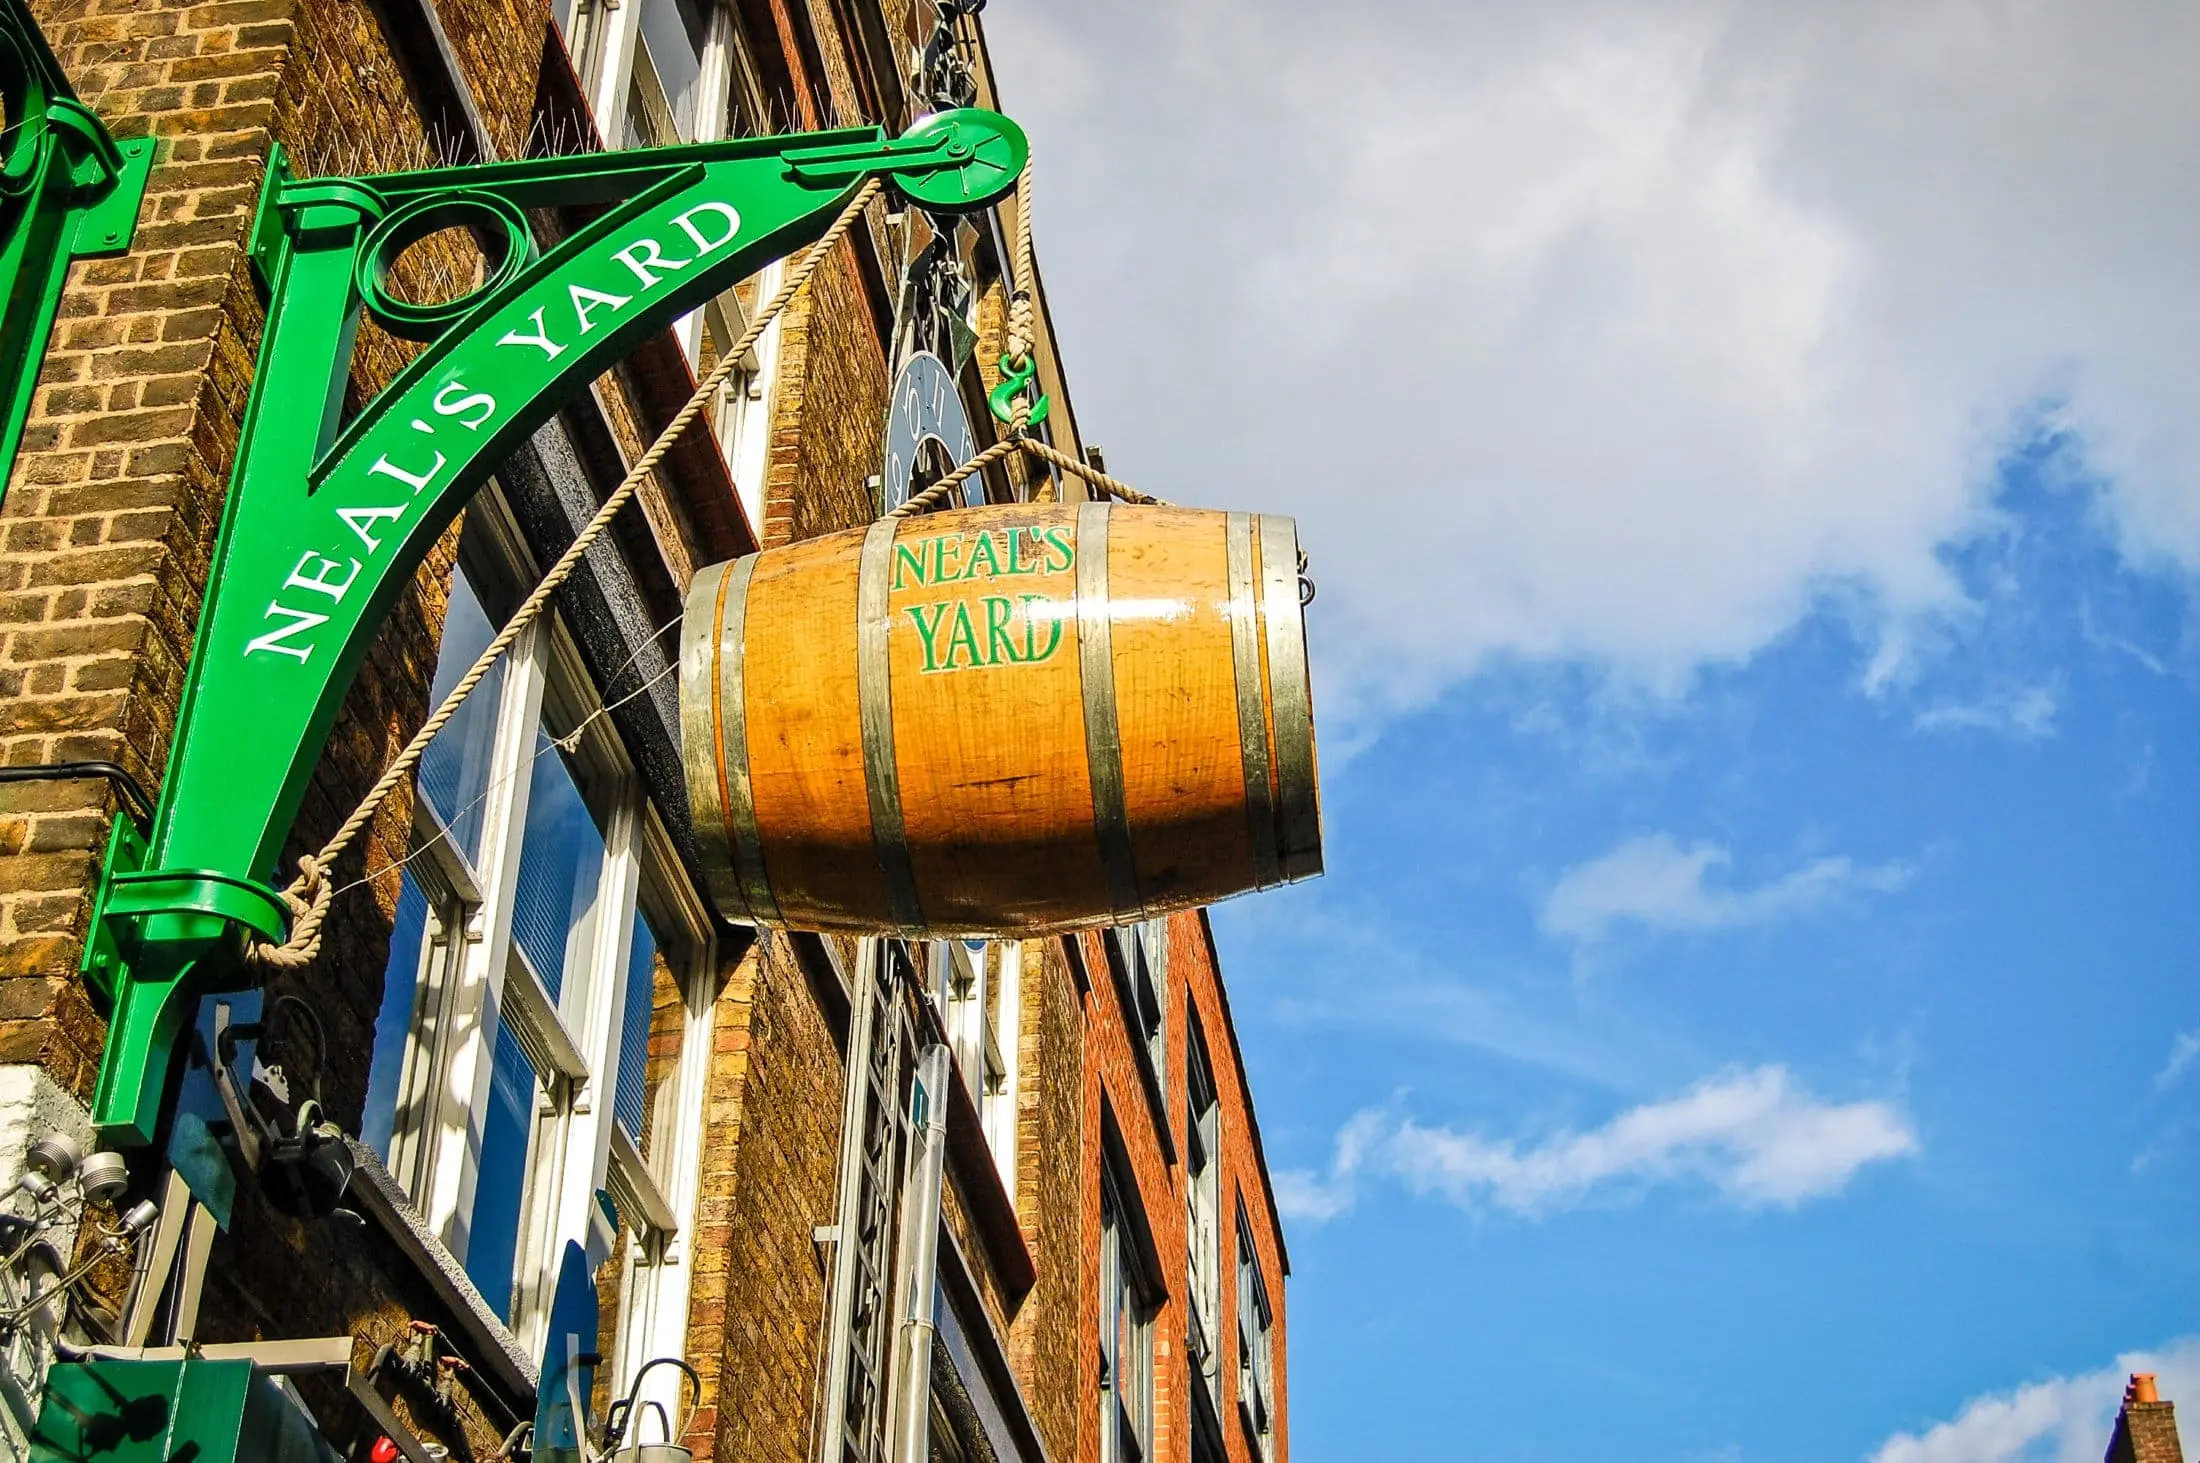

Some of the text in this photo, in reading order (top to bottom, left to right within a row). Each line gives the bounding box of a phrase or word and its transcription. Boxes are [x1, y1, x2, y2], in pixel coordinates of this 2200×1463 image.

[244, 202, 742, 665] NEAL'S YARD
[892, 527, 1075, 592] NEAL'S
[904, 594, 1064, 674] YARD
